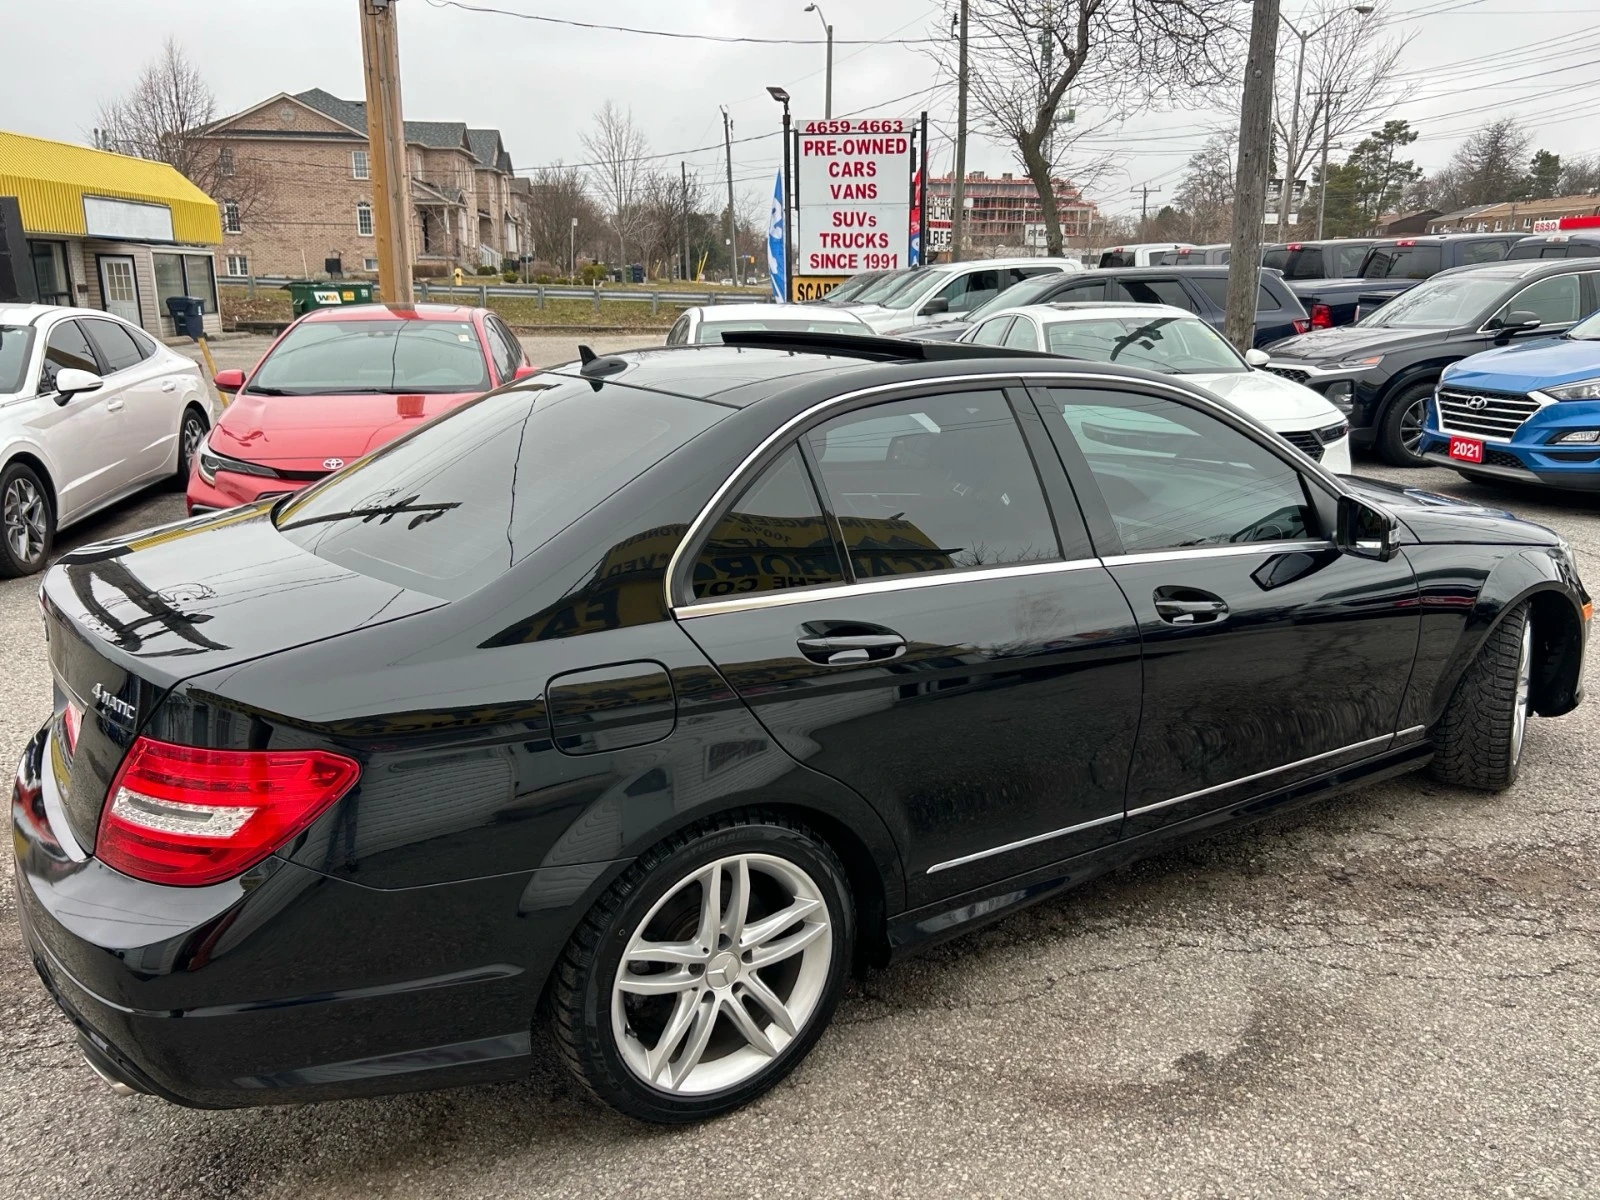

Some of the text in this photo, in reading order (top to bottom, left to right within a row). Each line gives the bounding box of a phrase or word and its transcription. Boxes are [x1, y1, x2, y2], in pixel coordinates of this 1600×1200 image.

[805, 121, 903, 134] 4659-4663
[804, 138, 907, 156] PRE-OWNED
[829, 161, 877, 178] CARS
[830, 183, 878, 199] VANS
[832, 211, 877, 227] SUVs
[1535, 222, 1557, 232] ESSO
[819, 233, 889, 248] TRUCKS
[810, 253, 898, 269] SINCE 1991
[797, 283, 839, 301] SCAR
[1453, 441, 1480, 459] 2021
[91, 683, 136, 719] 4MATIC
